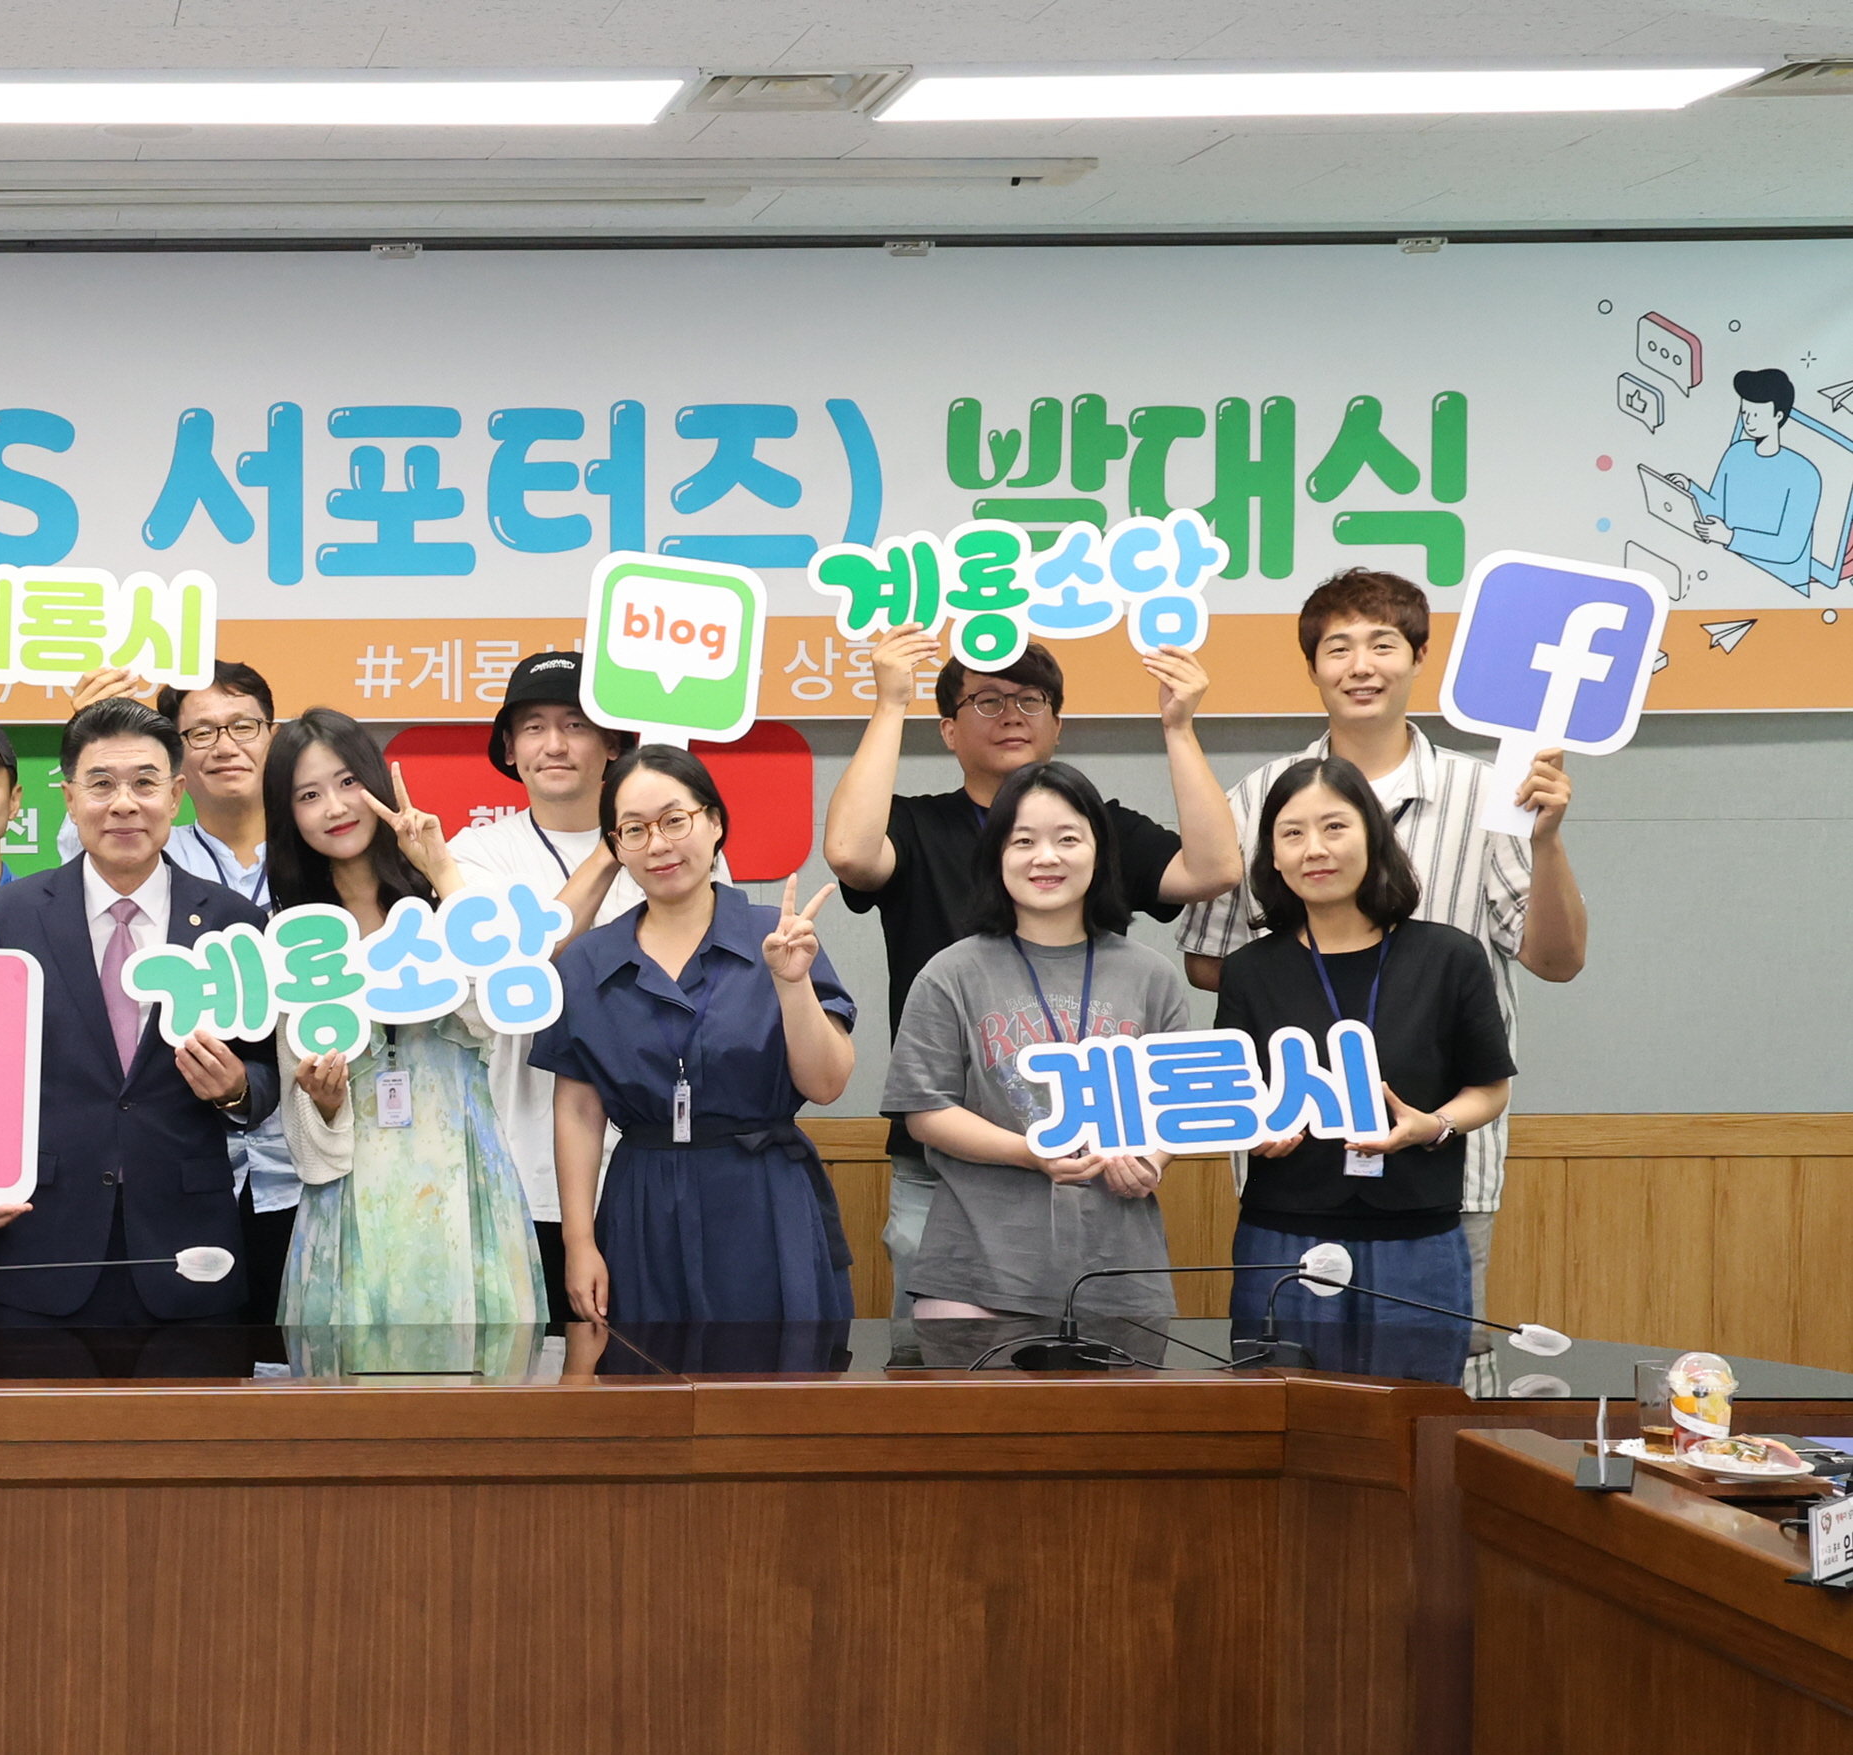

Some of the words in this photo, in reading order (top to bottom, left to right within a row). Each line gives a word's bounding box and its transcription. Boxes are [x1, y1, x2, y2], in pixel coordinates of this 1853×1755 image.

[141, 398, 883, 586] 서포터즈)
[622, 602, 727, 660] blog
[819, 517, 1221, 662] 계룡소담
[134, 883, 563, 1056] 계룡소담
[1029, 1030, 1379, 1150] 계룡시
